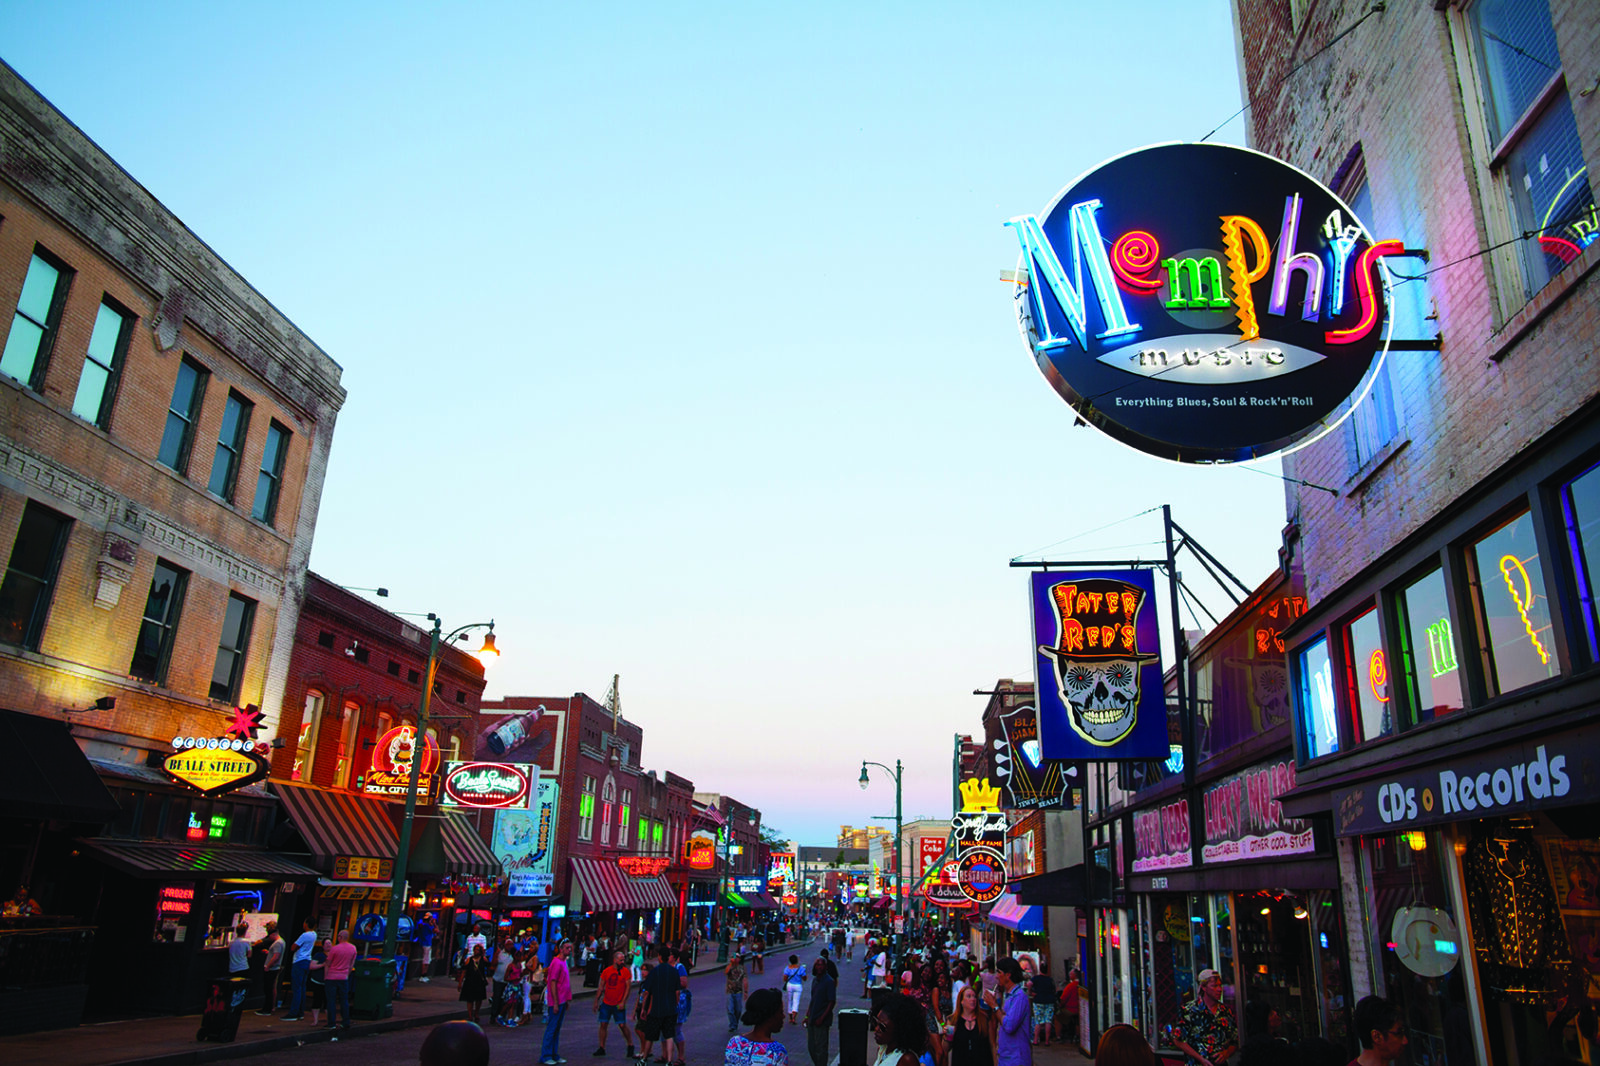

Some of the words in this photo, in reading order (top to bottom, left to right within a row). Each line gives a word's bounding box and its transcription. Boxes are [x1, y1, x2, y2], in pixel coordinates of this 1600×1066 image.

[1003, 192, 1406, 352] Memphis
[1138, 347, 1286, 366] music
[1115, 397, 1174, 408] Everything
[1177, 397, 1211, 408] Blues,
[1213, 397, 1237, 407] Soul
[1239, 397, 1248, 407] &
[1014, 717, 1038, 728] BLA
[1011, 727, 1038, 742] DIAM
[168, 759, 205, 773] BEALE
[208, 760, 253, 774] STREET
[365, 785, 389, 794] SOUL
[388, 786, 407, 794] CITY
[1378, 782, 1418, 823] CDs
[1439, 744, 1571, 815] Records
[1203, 777, 1242, 841] LUCKY
[538, 807, 552, 851] BLUES
[1250, 837, 1270, 853] OTHER
[1271, 836, 1288, 850] COOL
[1289, 830, 1312, 849] STUFF
[923, 844, 943, 853] Coke
[969, 854, 993, 865] BAR
[959, 870, 1004, 884] RESTAURANT
[1152, 877, 1169, 889] ENTER
[164, 887, 195, 900] FROZEN
[937, 885, 964, 897] Schwa
[161, 901, 192, 913] DRINKS
